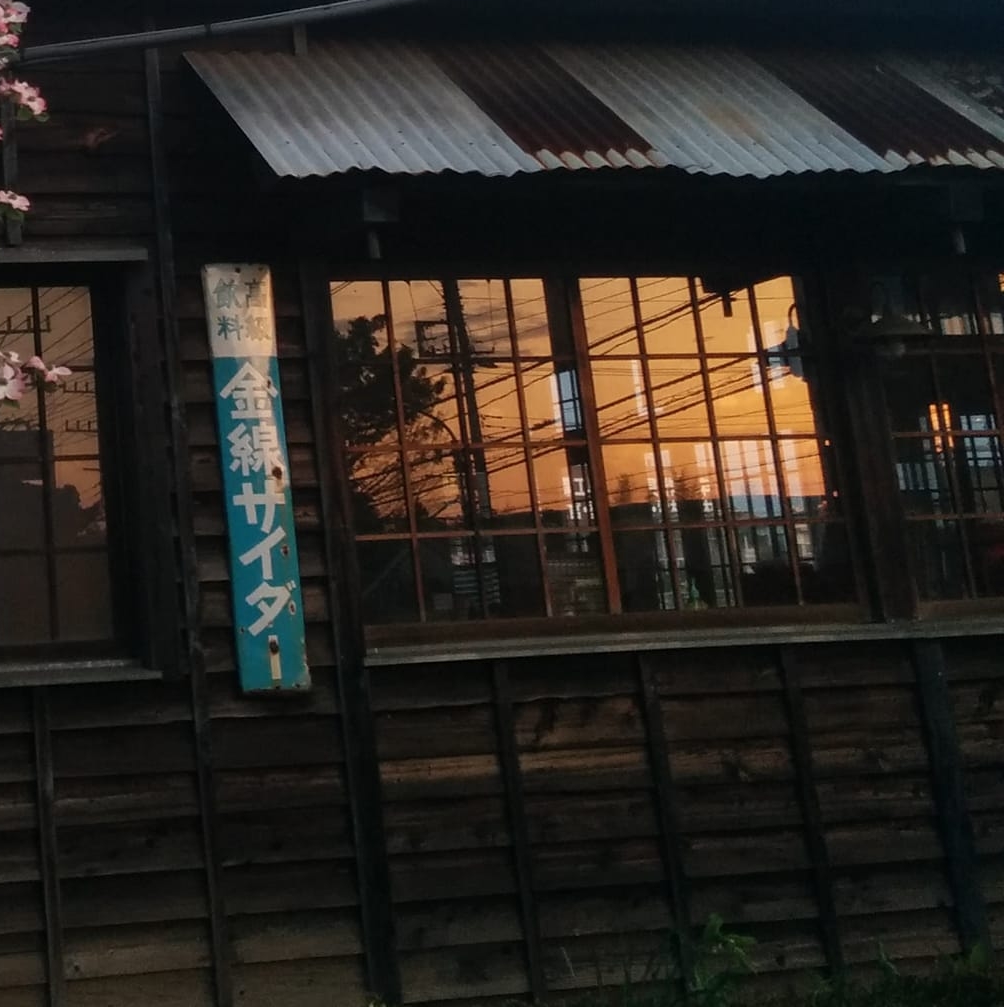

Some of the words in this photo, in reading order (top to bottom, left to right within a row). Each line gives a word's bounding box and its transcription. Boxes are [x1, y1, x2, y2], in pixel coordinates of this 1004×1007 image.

[219, 362, 296, 680] 金線サイダー
